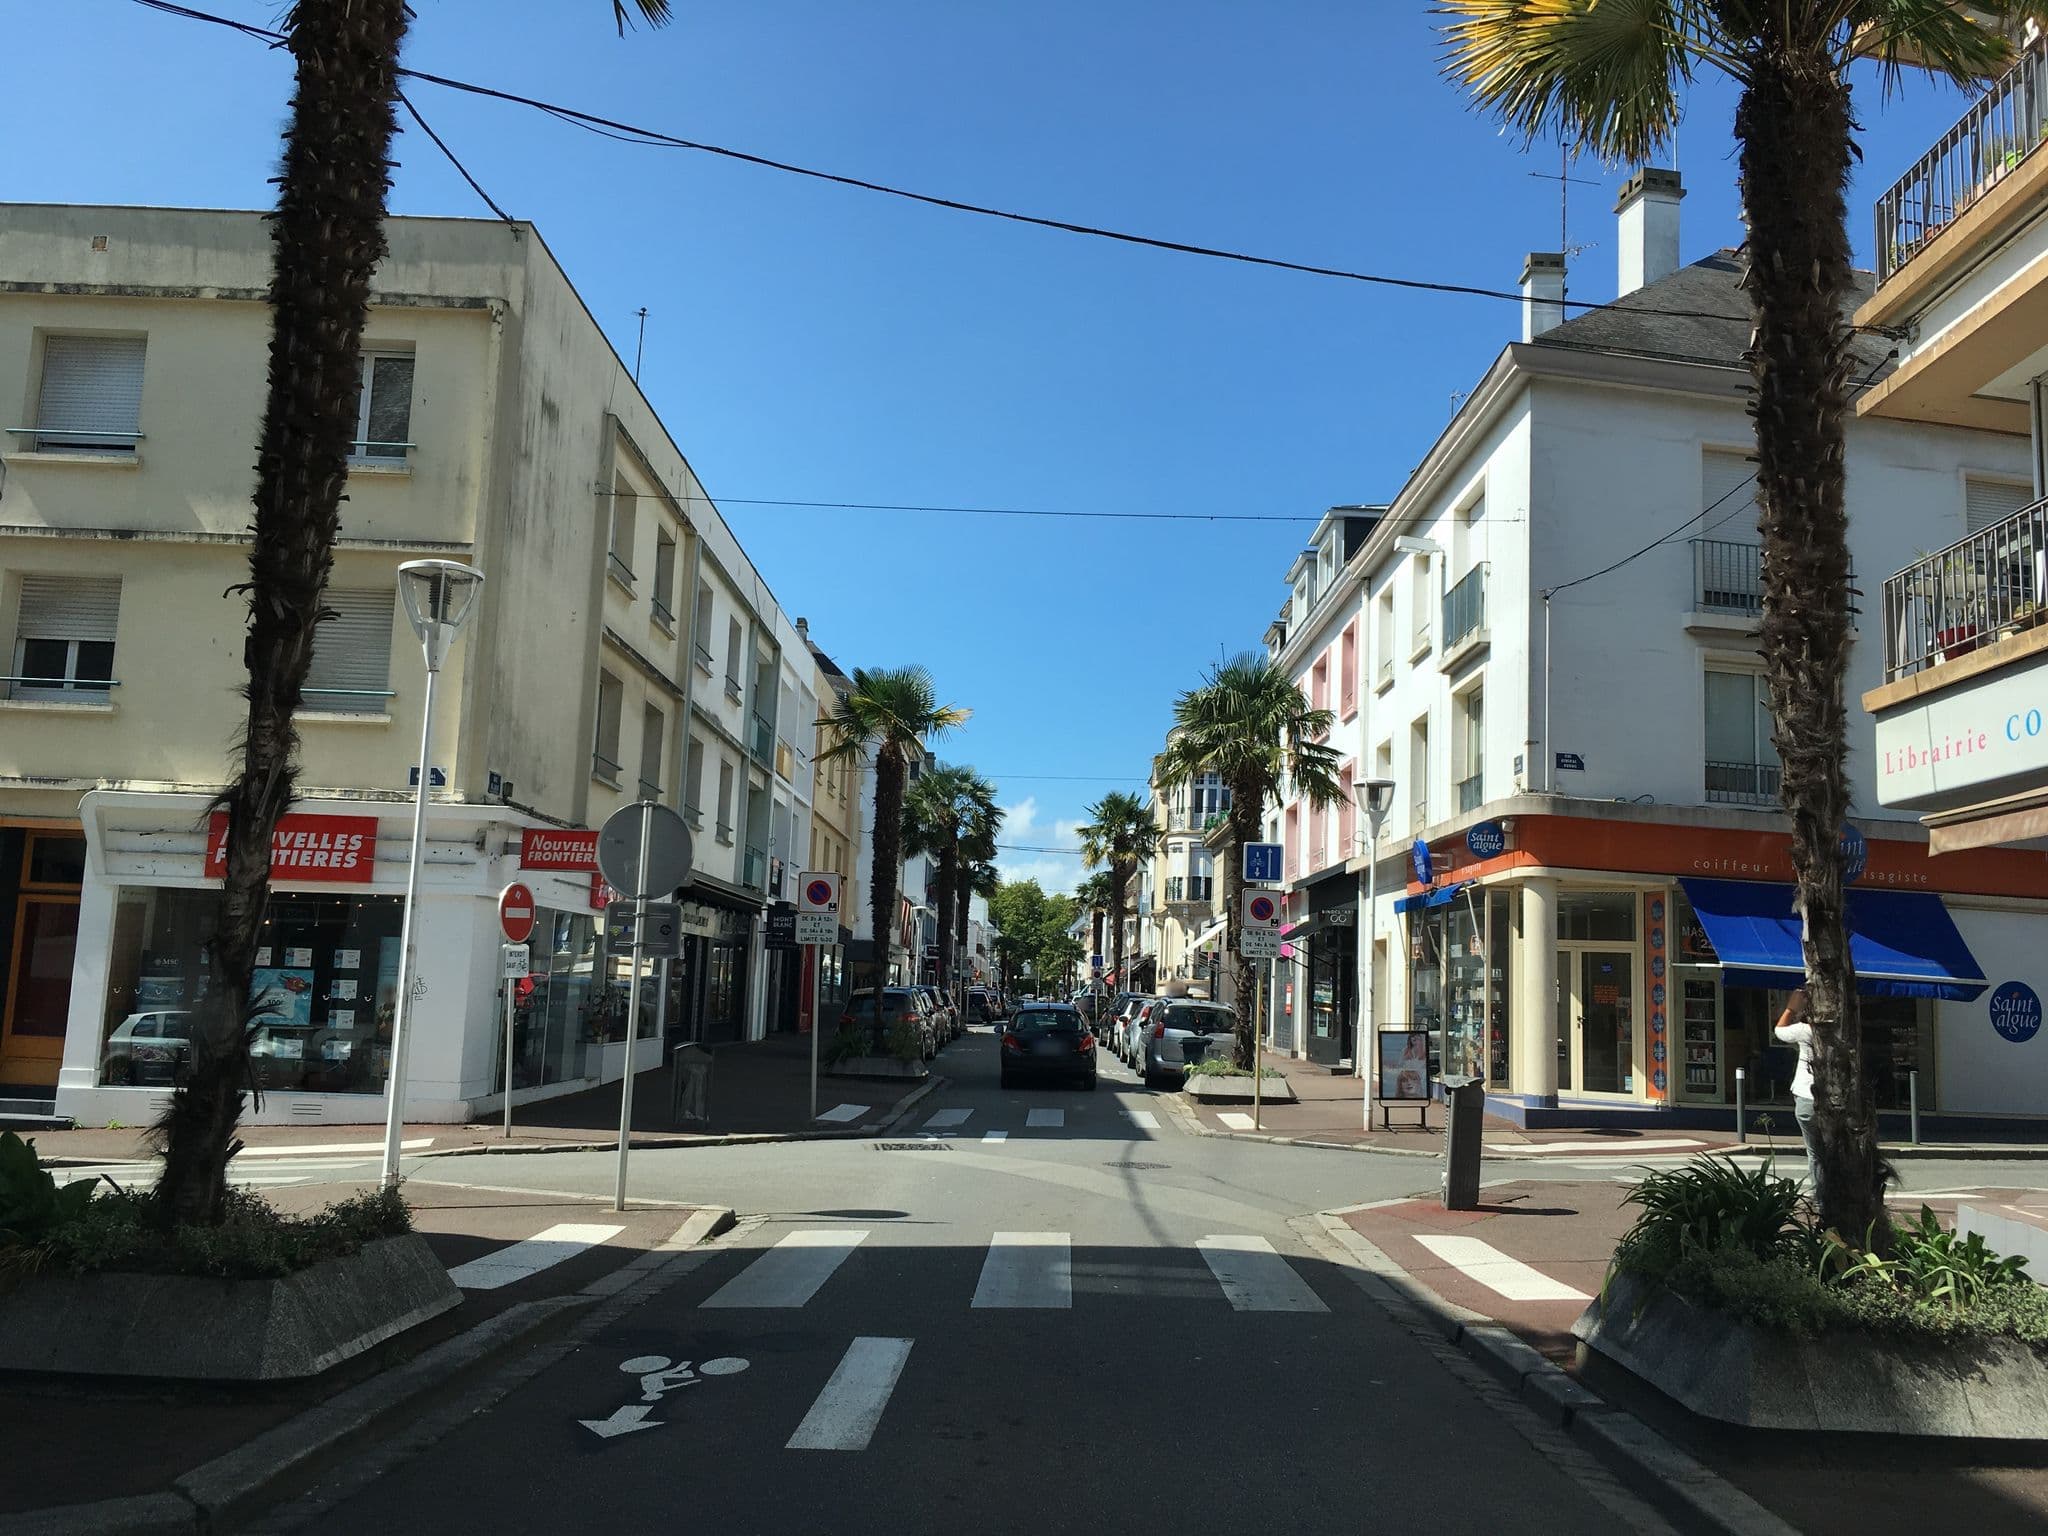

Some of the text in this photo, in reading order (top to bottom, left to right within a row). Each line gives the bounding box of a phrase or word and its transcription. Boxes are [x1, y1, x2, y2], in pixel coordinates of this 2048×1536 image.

[1885, 729, 1987, 775] Librairie
[220, 825, 363, 850] VELLES
[1470, 832, 1499, 843] Saint
[1472, 840, 1502, 853] algue
[214, 847, 358, 868] FTIERES
[1693, 859, 1769, 873] coiffeur
[1991, 996, 2034, 1013] Saint
[1996, 1007, 2039, 1035] algue
